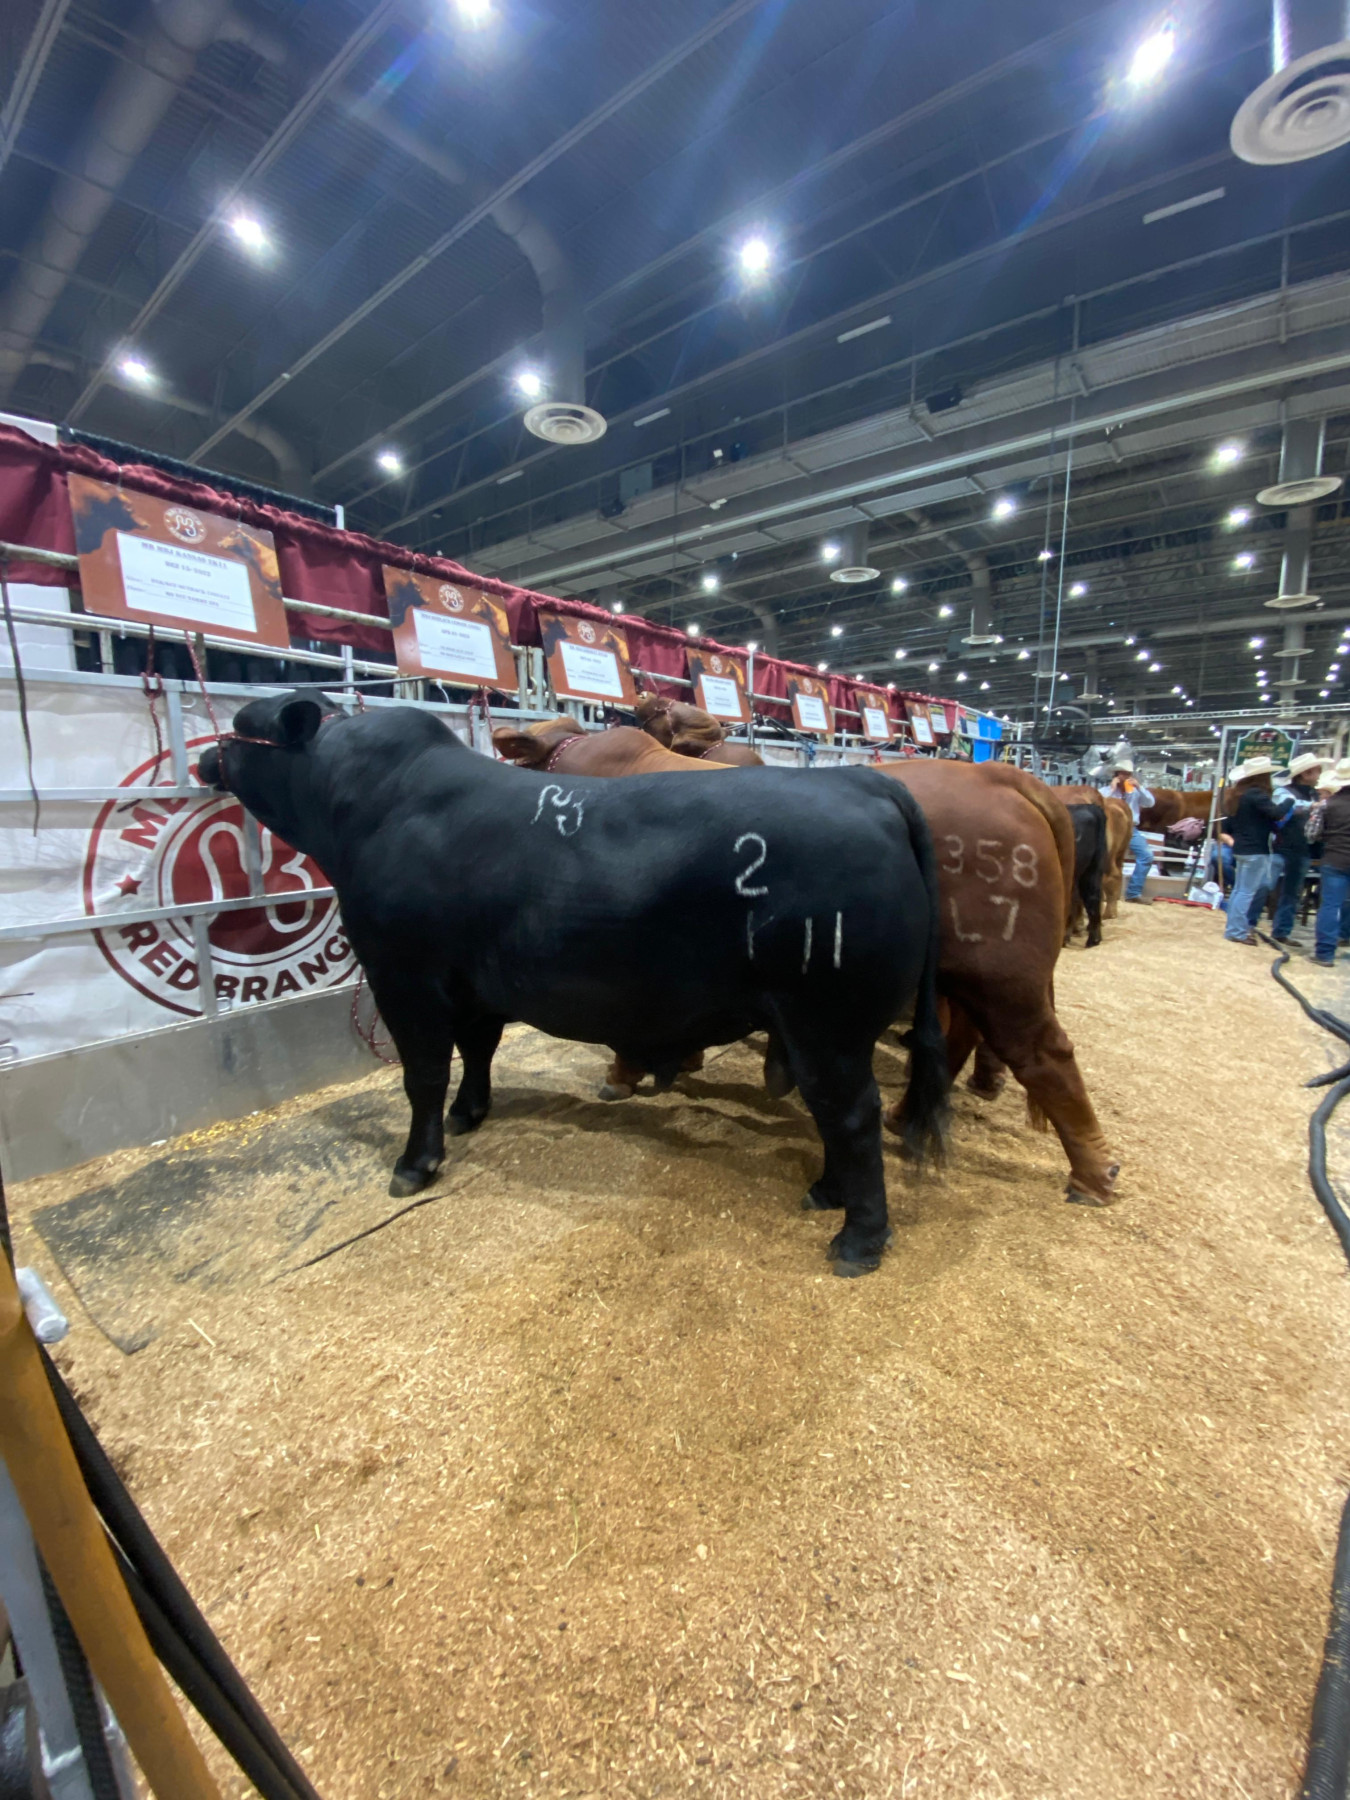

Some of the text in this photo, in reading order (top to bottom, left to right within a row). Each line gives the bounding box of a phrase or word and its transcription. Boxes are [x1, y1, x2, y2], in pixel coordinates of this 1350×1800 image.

[734, 832, 769, 896] 2
[943, 834, 1039, 888] 358
[950, 895, 1019, 942] L7
[118, 921, 200, 991] RED
[215, 925, 351, 1003] BRANG
